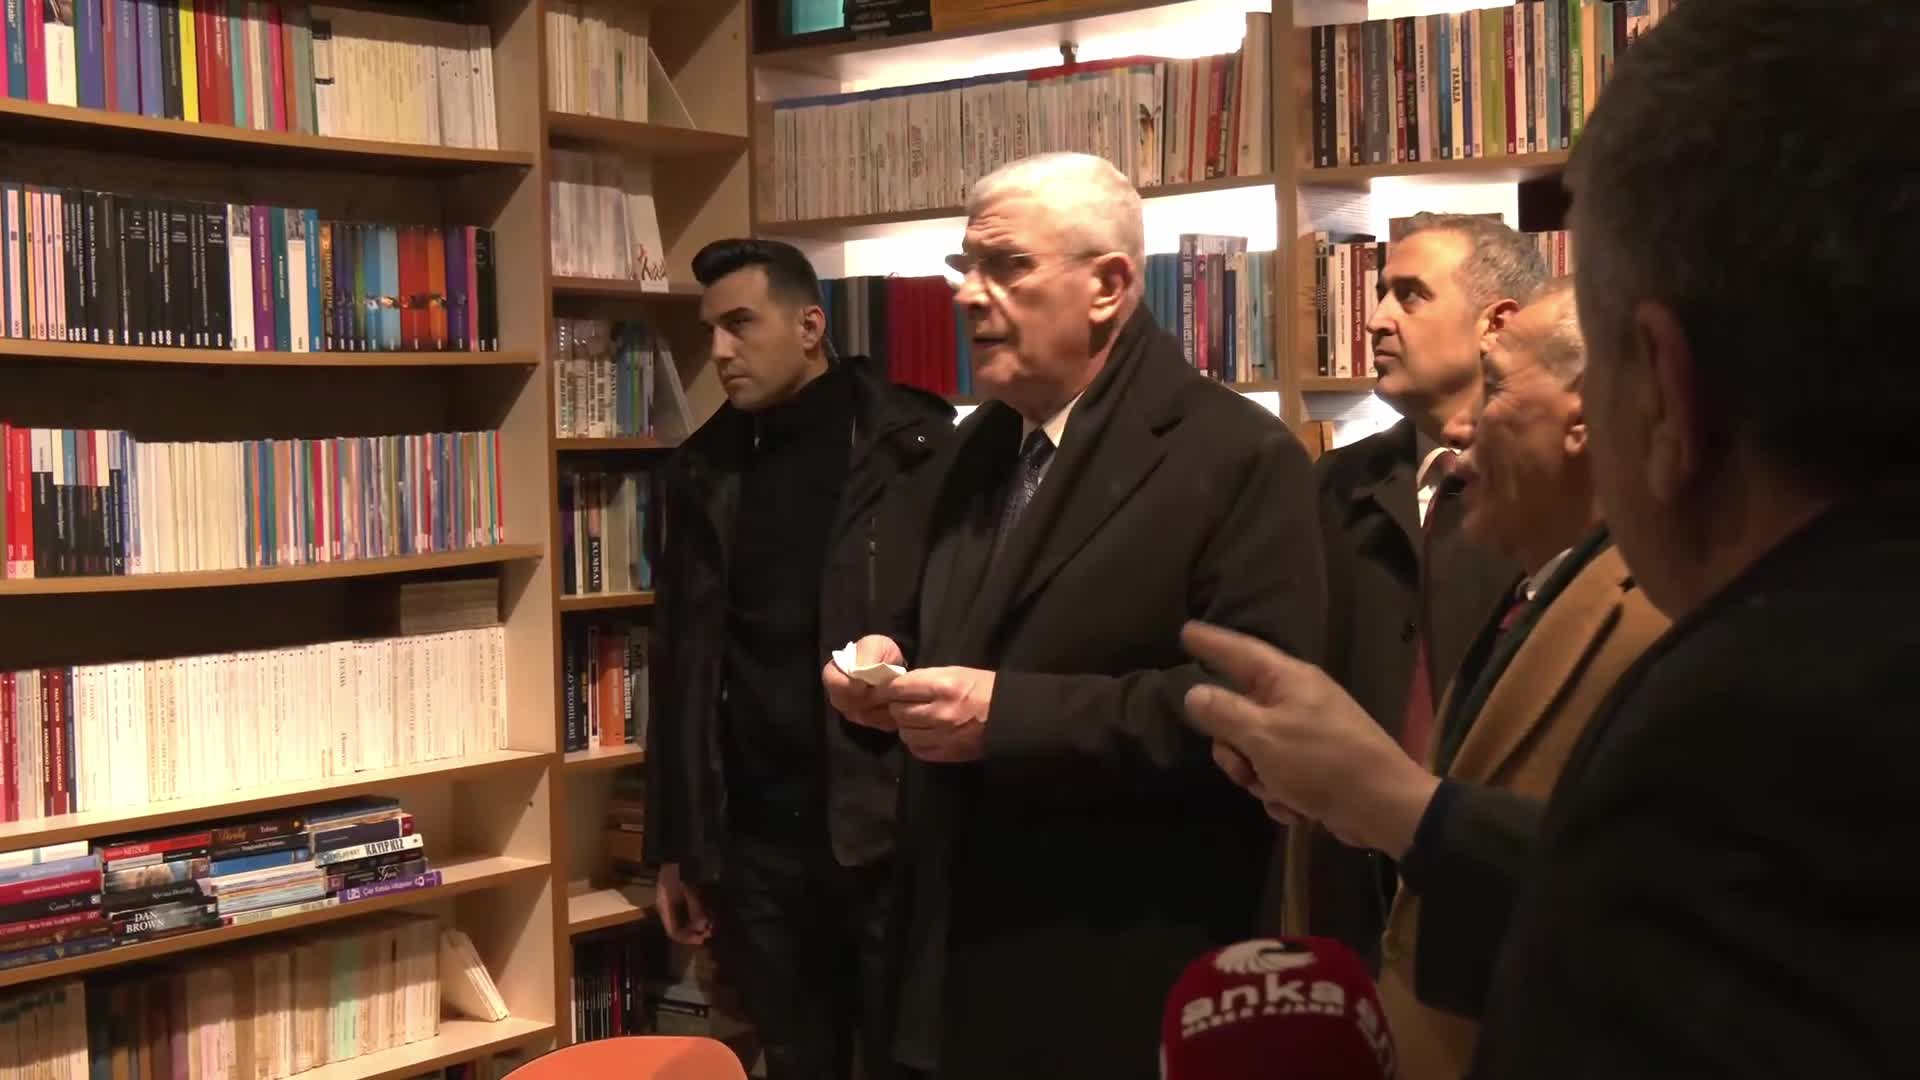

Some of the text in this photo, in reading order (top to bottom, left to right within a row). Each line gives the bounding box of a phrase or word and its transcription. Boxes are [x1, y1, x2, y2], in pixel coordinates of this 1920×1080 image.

[592, 541, 600, 587] KUMSAL
[364, 840, 390, 856] KAYIP
[390, 838, 404, 853] KIZ
[134, 911, 158, 922] DAN
[126, 920, 166, 934] BROWN
[1181, 973, 1345, 1026] anka
